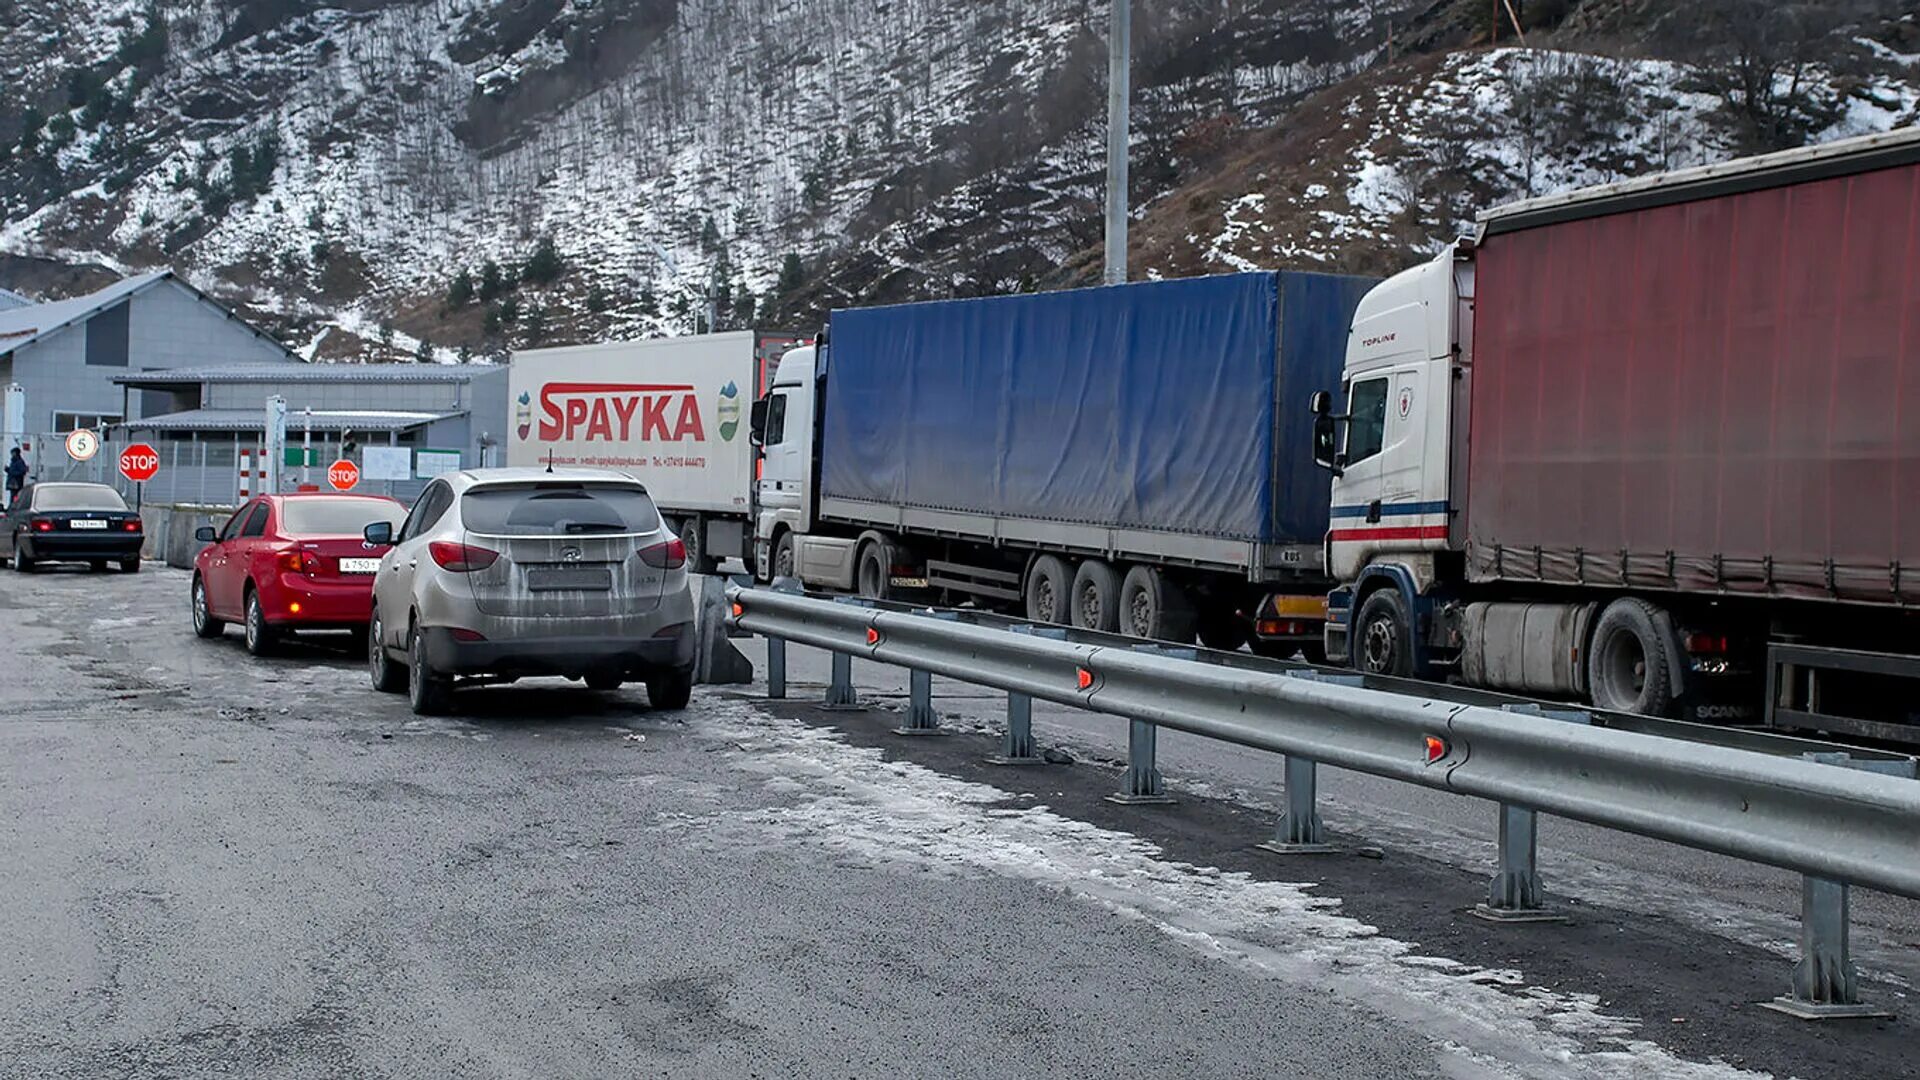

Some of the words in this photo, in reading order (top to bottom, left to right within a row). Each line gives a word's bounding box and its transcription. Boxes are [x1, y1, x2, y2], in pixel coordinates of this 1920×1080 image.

[1362, 332, 1396, 348] TOPLINE
[538, 382, 706, 441] SPAYKA
[77, 438, 86, 451] 5
[120, 455, 158, 470] STOP
[538, 456, 577, 466] wwwspayka.com
[329, 470, 357, 483] STOP
[1284, 551, 1300, 562] RUS
